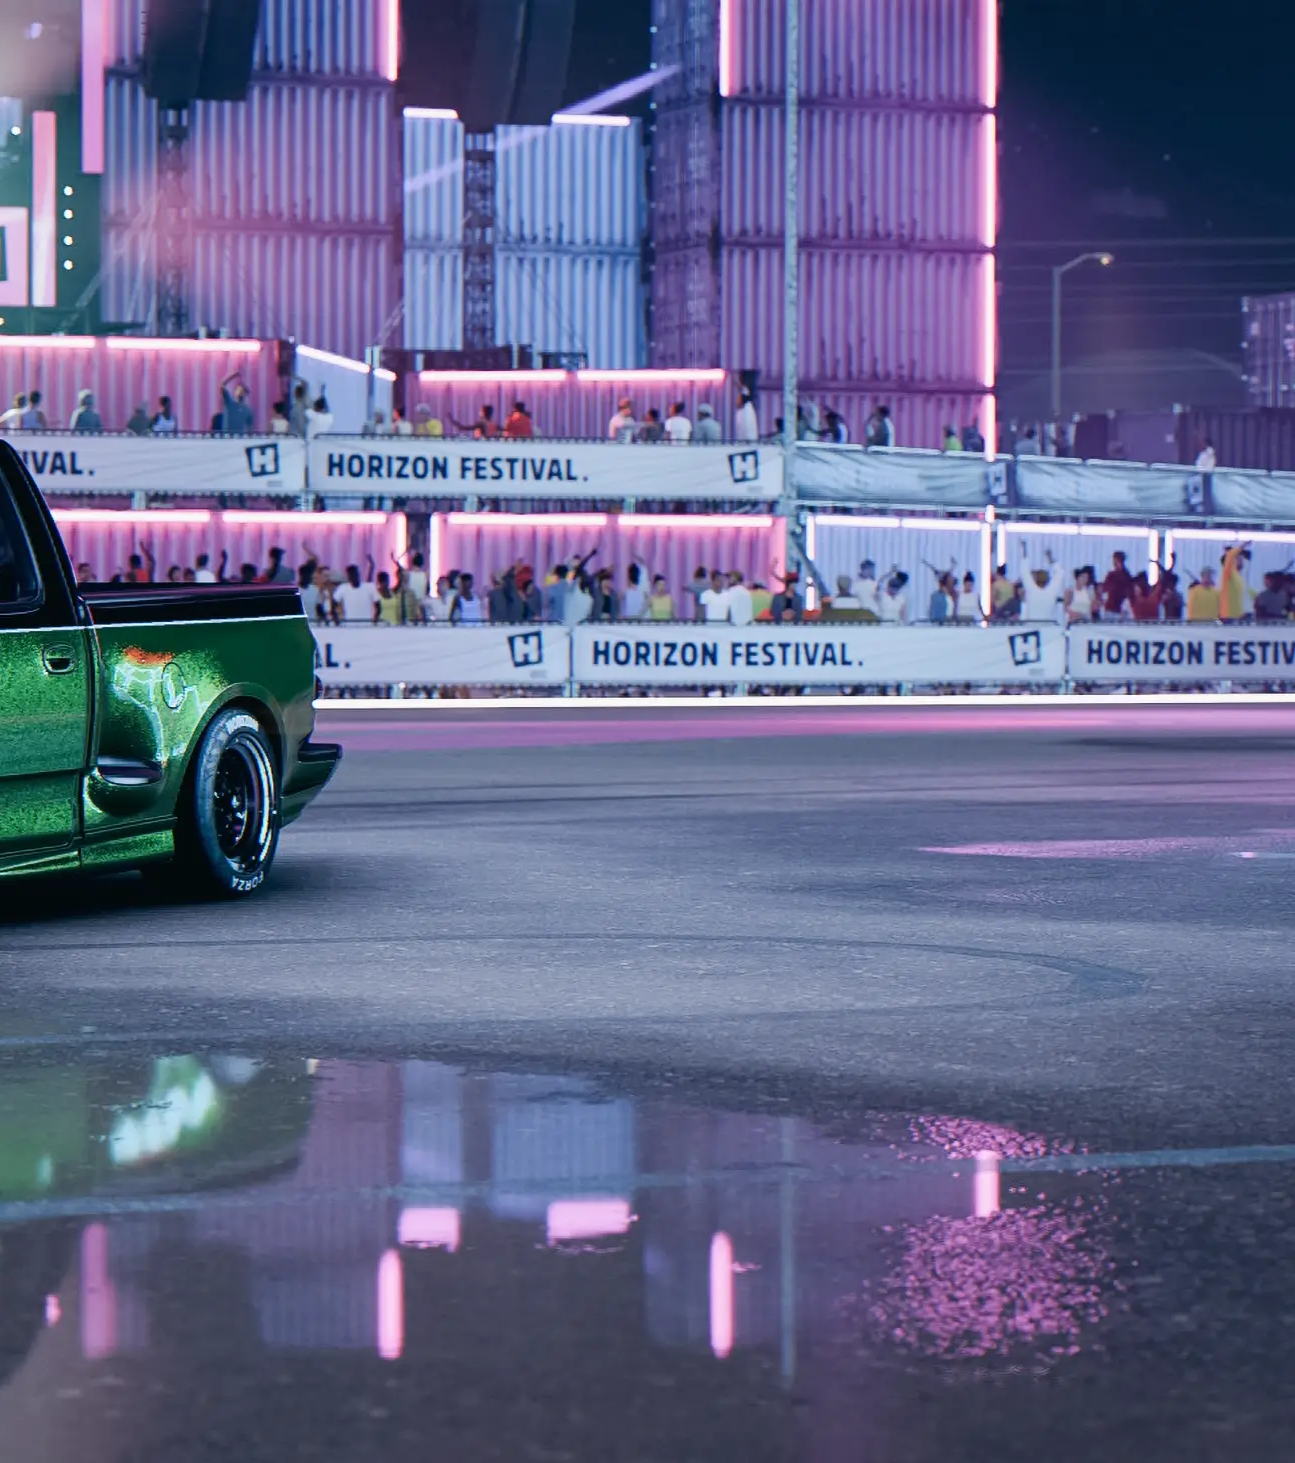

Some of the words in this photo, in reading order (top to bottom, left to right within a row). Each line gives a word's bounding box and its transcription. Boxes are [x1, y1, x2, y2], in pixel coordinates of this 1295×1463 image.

[327, 453, 448, 480] HORIZON
[460, 456, 588, 482] FESTIVAL.
[593, 640, 718, 667] HORIZON
[731, 642, 864, 667] FESTIVAL.
[1087, 639, 1204, 666] HORIZON
[1214, 640, 1295, 666] FESTIV
[231, 870, 265, 892] FORZA
